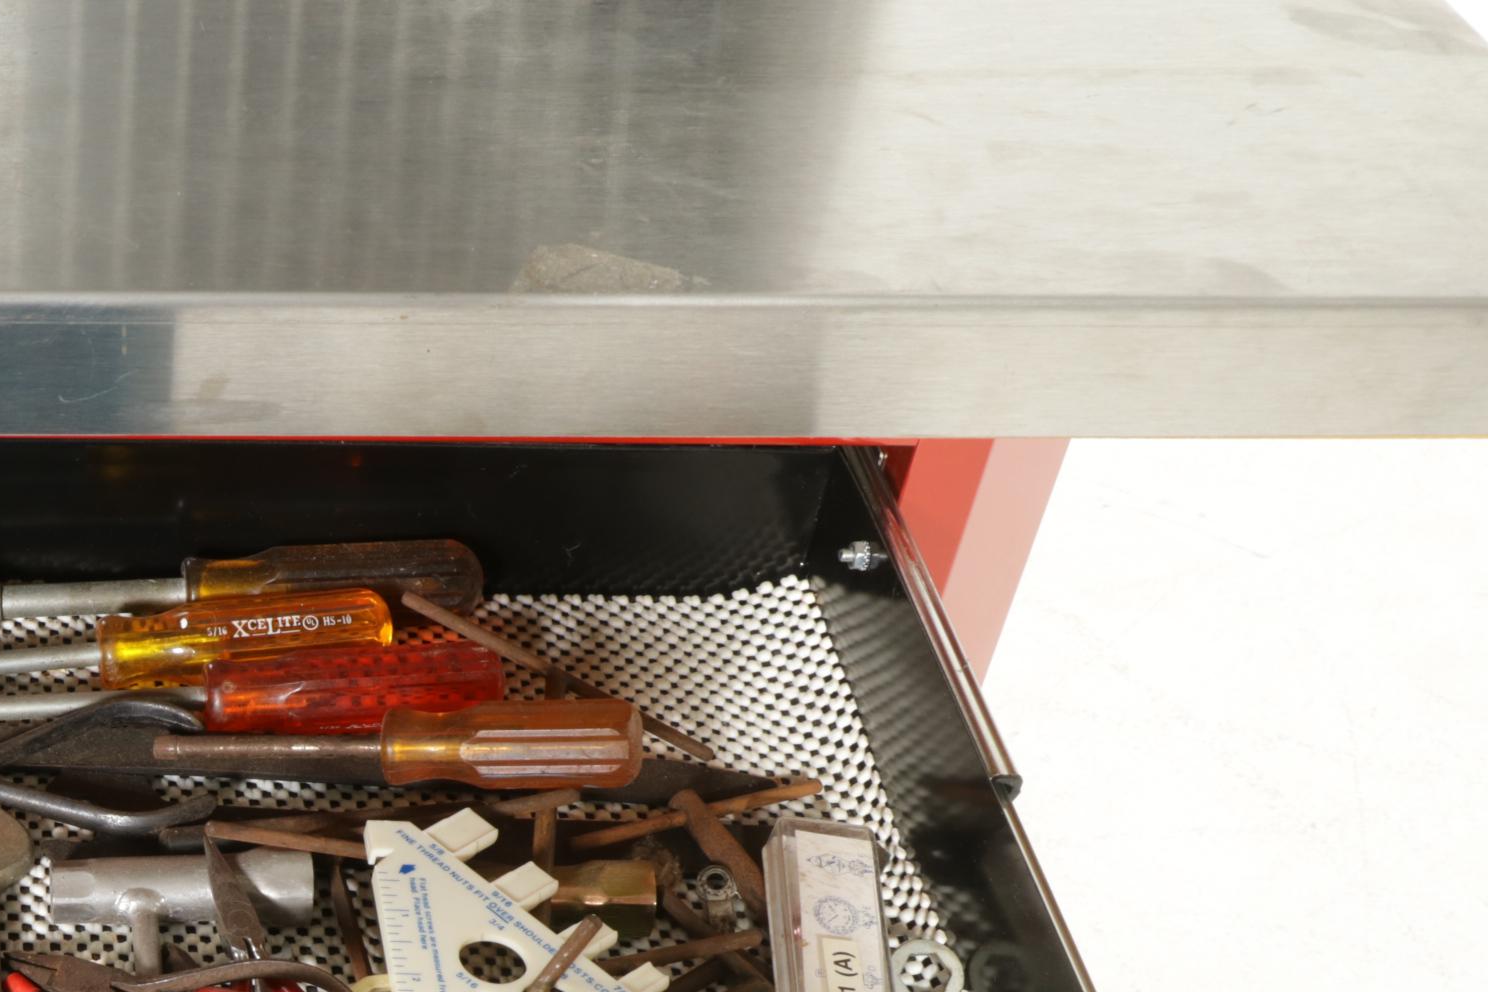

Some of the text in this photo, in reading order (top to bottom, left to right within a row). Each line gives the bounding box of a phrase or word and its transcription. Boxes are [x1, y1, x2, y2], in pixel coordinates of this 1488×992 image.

[206, 626, 228, 637] 5/16
[322, 614, 353, 627] HS-10
[428, 843, 446, 857] 5/8
[395, 829, 417, 845] FINE
[416, 844, 451, 872] THREAD
[448, 870, 476, 892] NUTS
[471, 888, 494, 903] FIT
[486, 901, 513, 923] OVER
[513, 920, 557, 955] SHOULDE
[490, 890, 513, 908] 9/16
[488, 918, 507, 931] 3/4
[831, 951, 859, 978] (A)
[454, 971, 480, 990] 5/16
